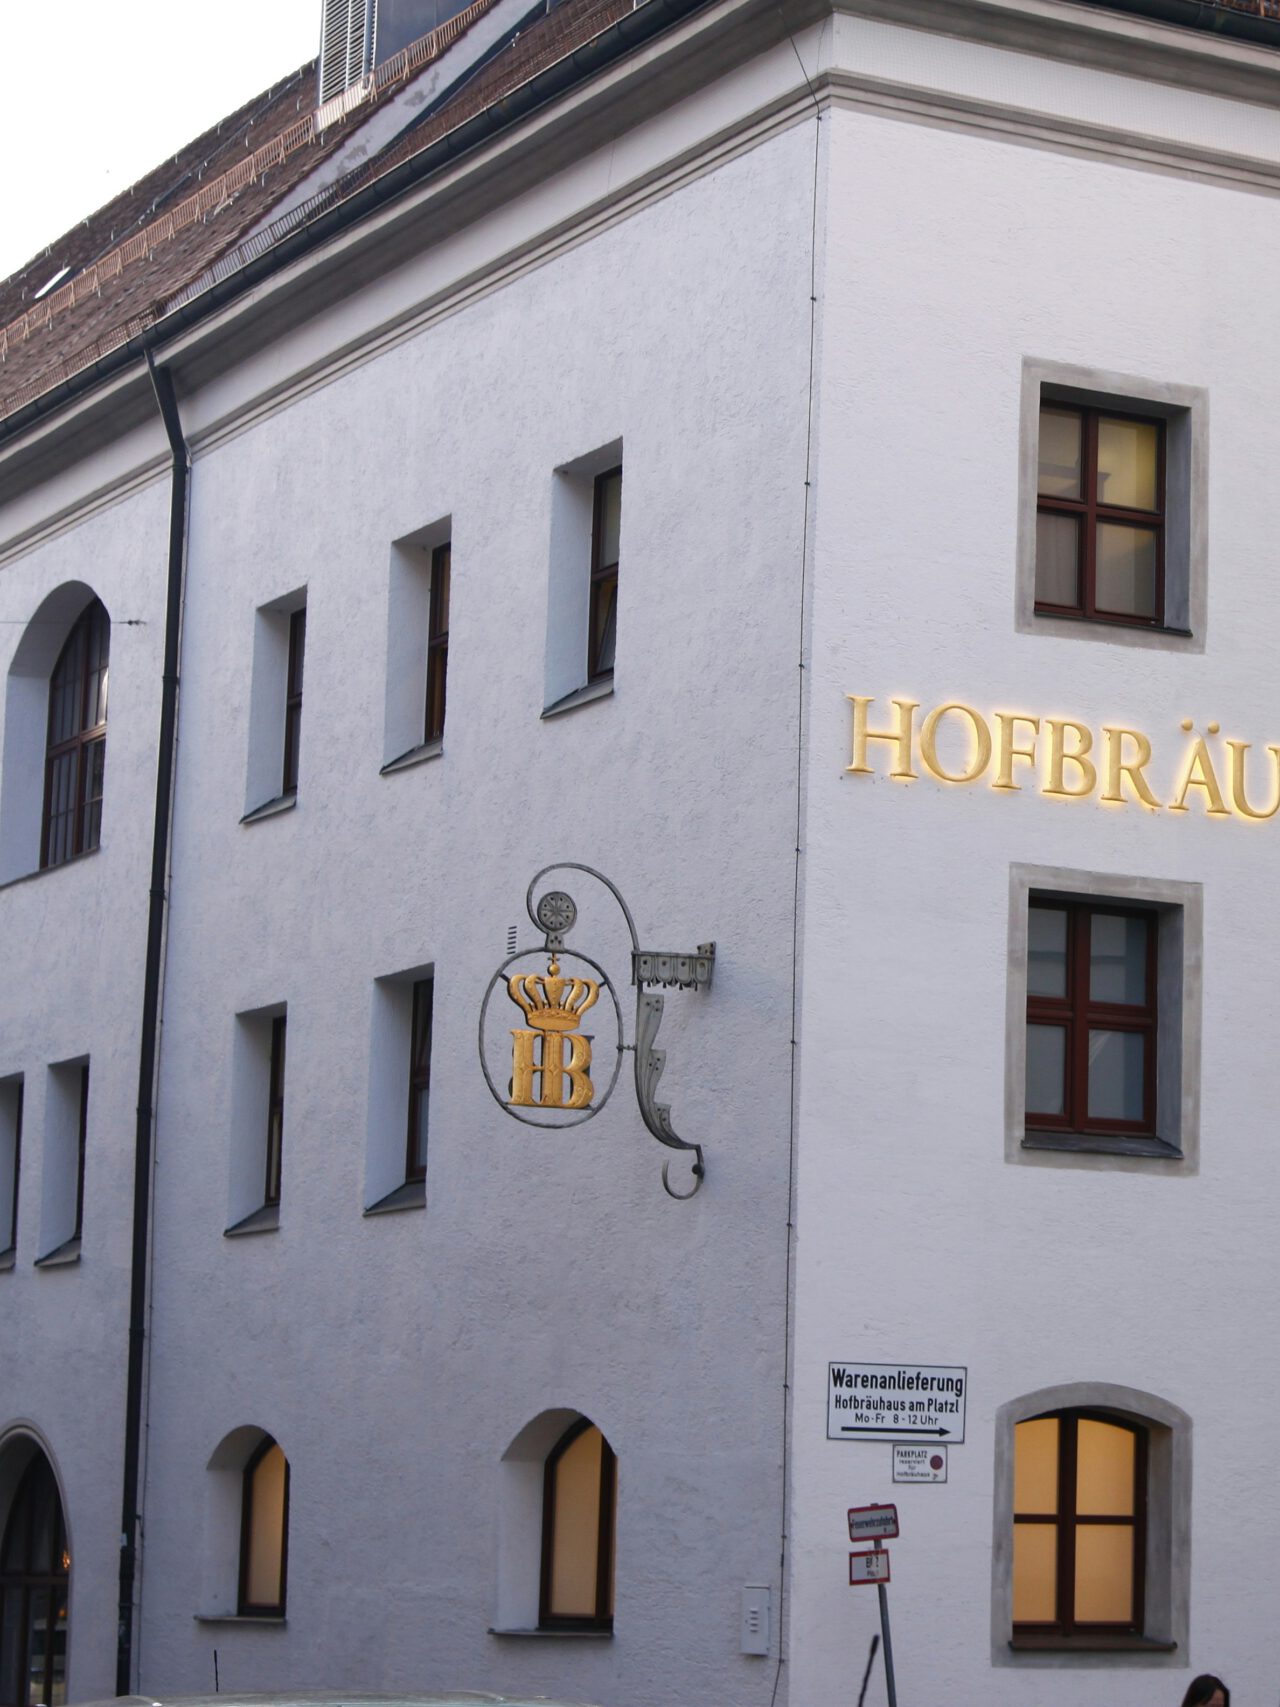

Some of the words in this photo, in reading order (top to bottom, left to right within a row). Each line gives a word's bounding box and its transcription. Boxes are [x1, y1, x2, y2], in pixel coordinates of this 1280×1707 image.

[509, 1029, 594, 1108] HB
[832, 1368, 963, 1397] Warenanlieferung
[835, 1395, 906, 1411] Hofbräuhaus
[909, 1401, 925, 1412] am
[927, 1398, 960, 1413] Platzl
[893, 1413, 899, 1424] 8
[908, 1414, 917, 1425] 12
[920, 1415, 938, 1425] Uhr
[896, 1450, 928, 1458] PARKPLATZ
